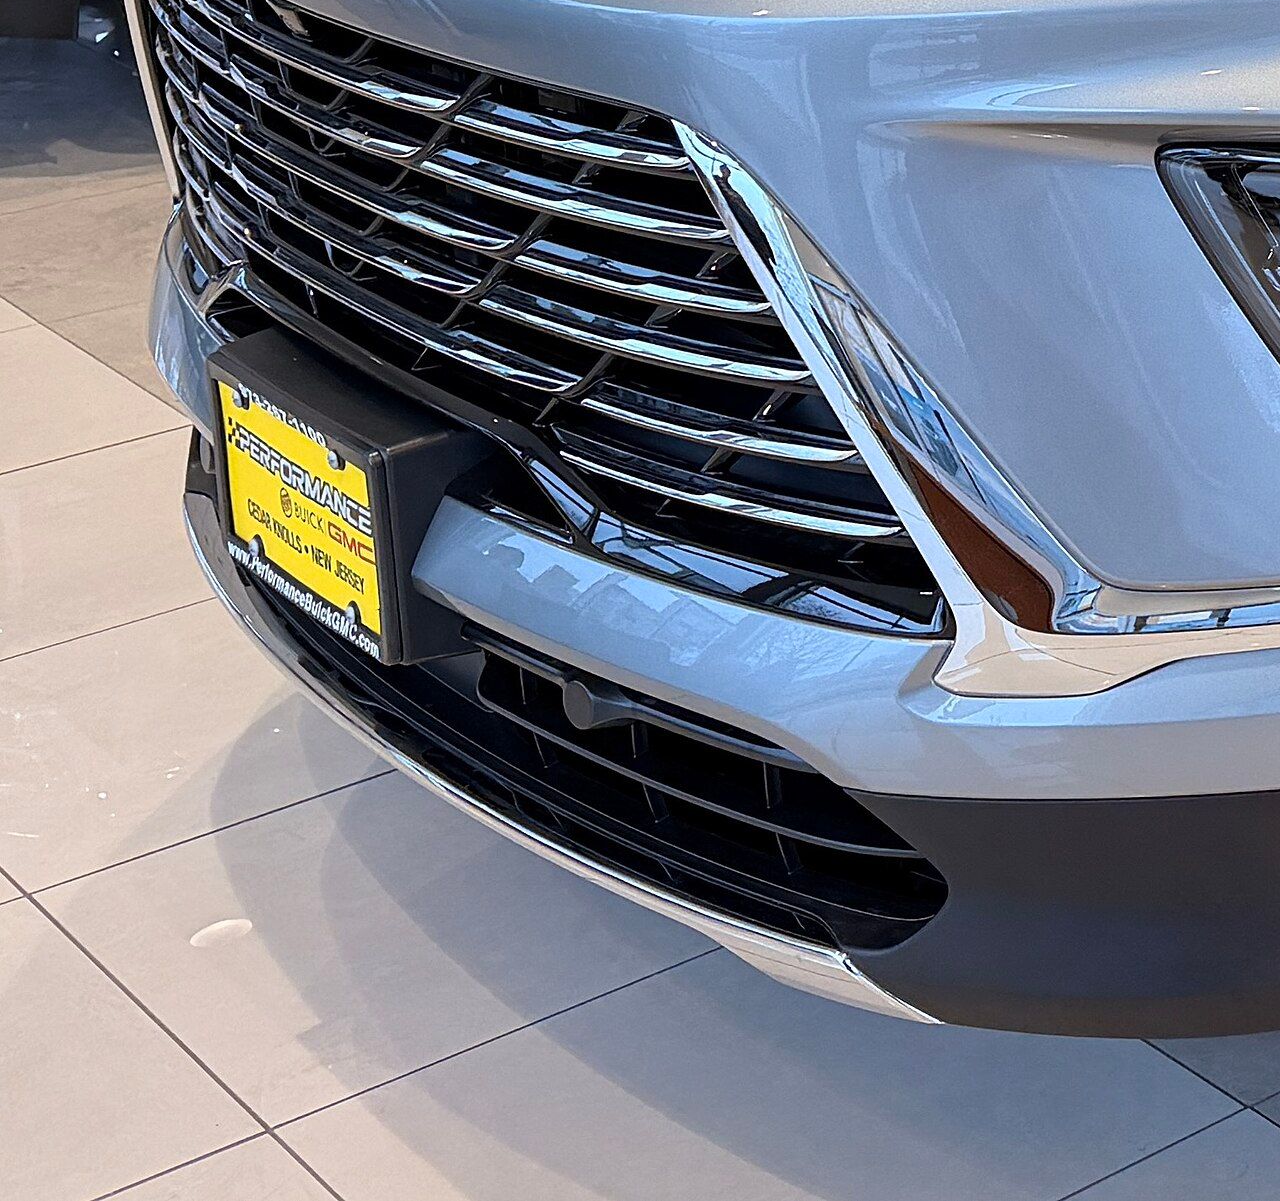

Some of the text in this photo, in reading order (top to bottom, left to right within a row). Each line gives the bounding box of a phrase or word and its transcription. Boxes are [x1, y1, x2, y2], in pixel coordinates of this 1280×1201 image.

[236, 424, 373, 537] PERFORMANCE
[247, 498, 365, 595] CEDAR KNOLLS NEW JERSEY
[294, 502, 376, 566] BUICK GMC
